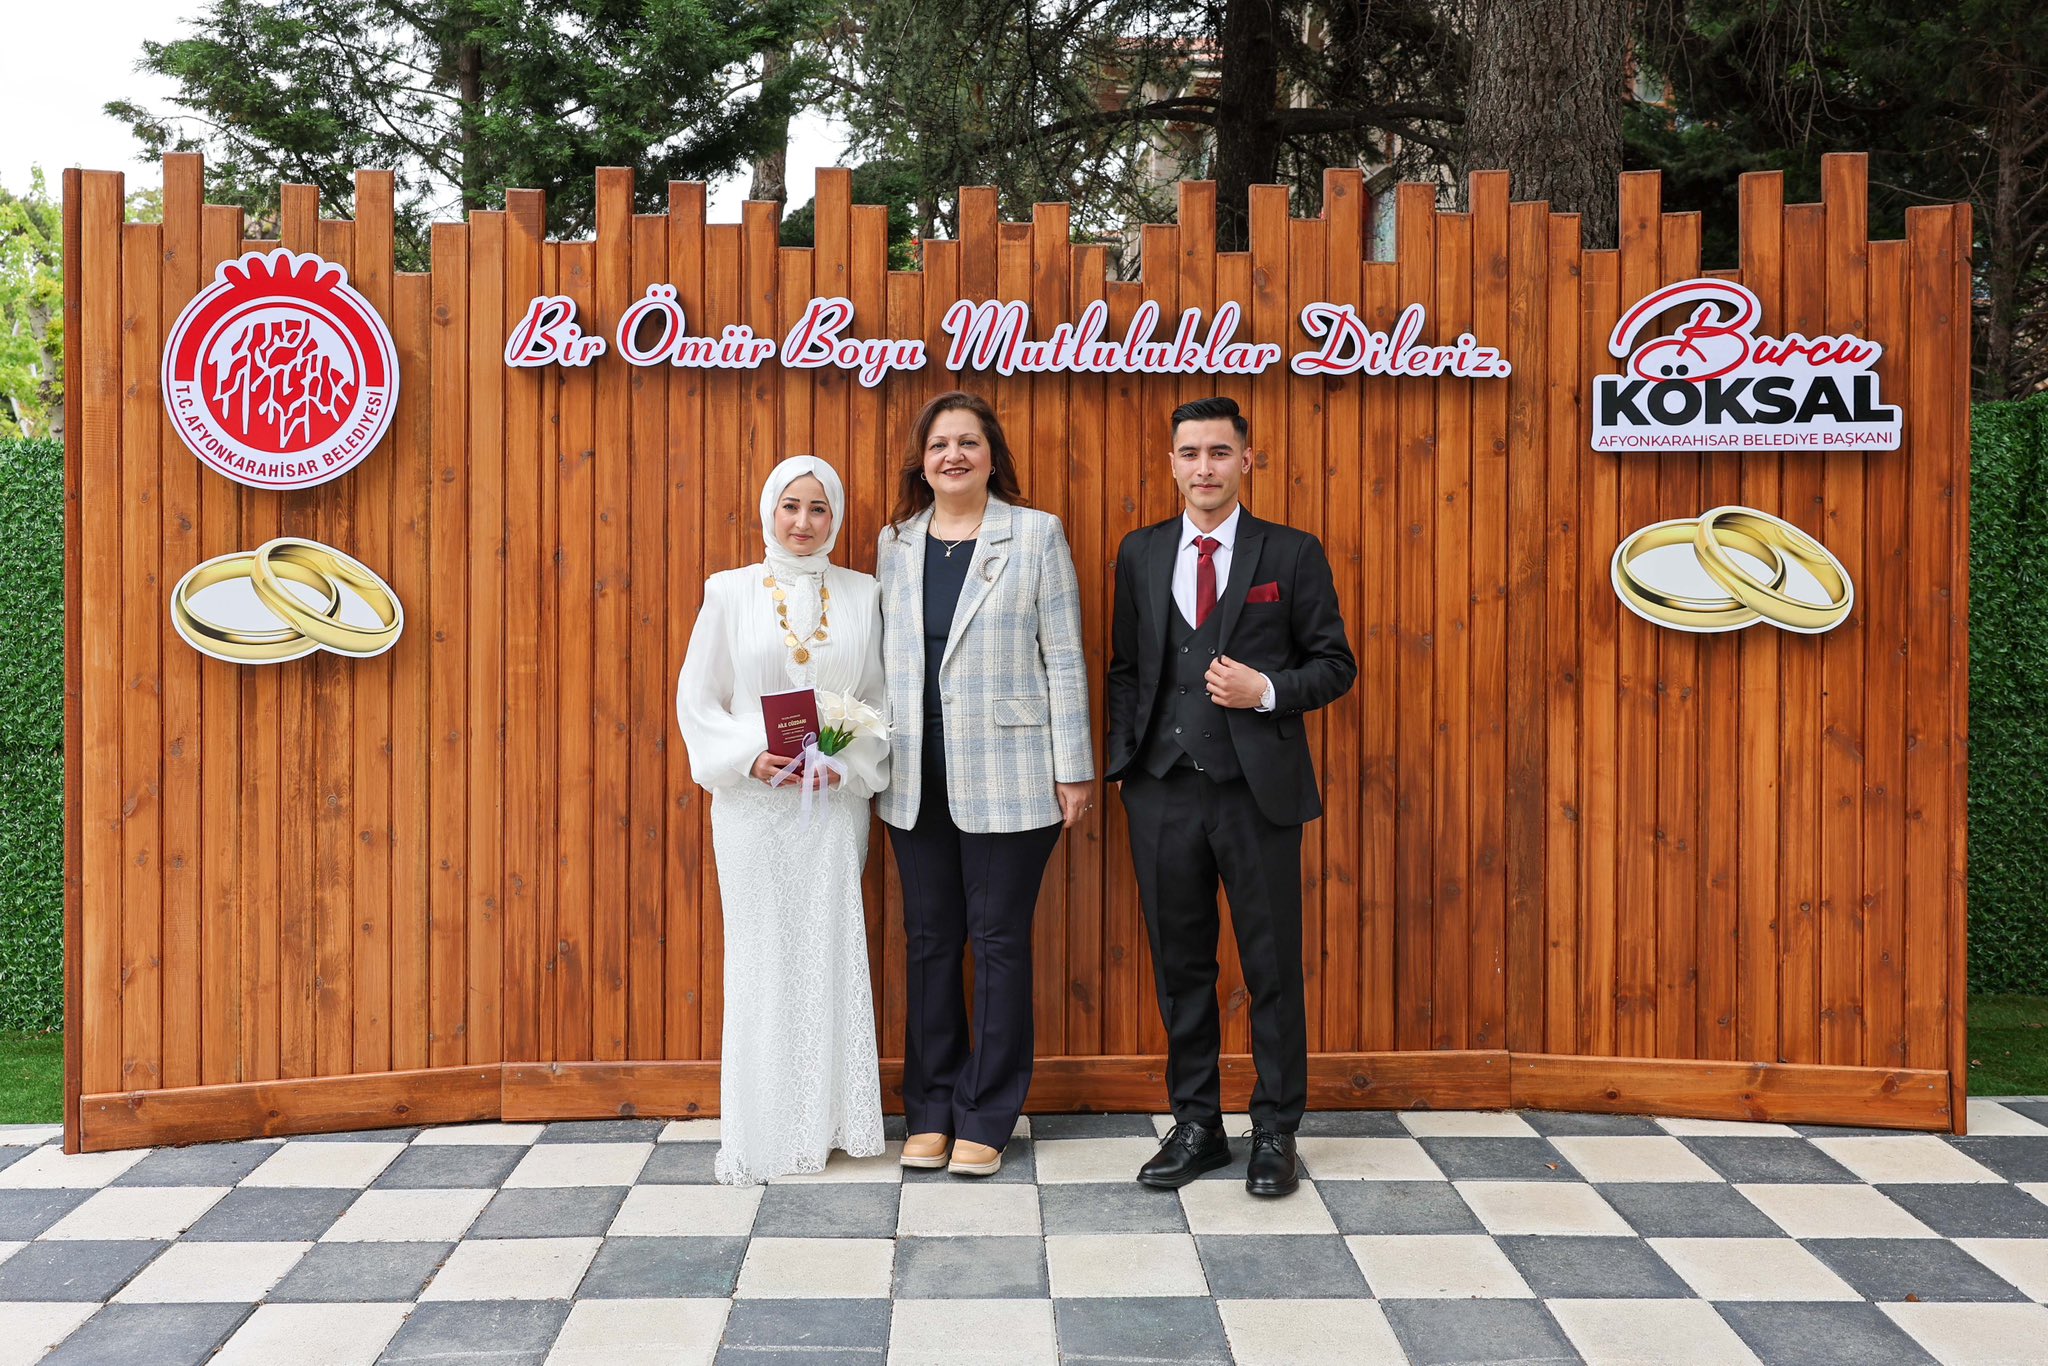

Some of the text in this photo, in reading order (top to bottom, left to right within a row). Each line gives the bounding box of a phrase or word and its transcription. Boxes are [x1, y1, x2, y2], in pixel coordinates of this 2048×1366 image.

[510, 289, 1507, 383] Bir Ömür Boyu Mutluluklar Dileriz.
[1616, 282, 1873, 383] Burcu
[1601, 364, 1894, 426] KÖKSAL
[1823, 432, 1893, 447] BAŞKANI
